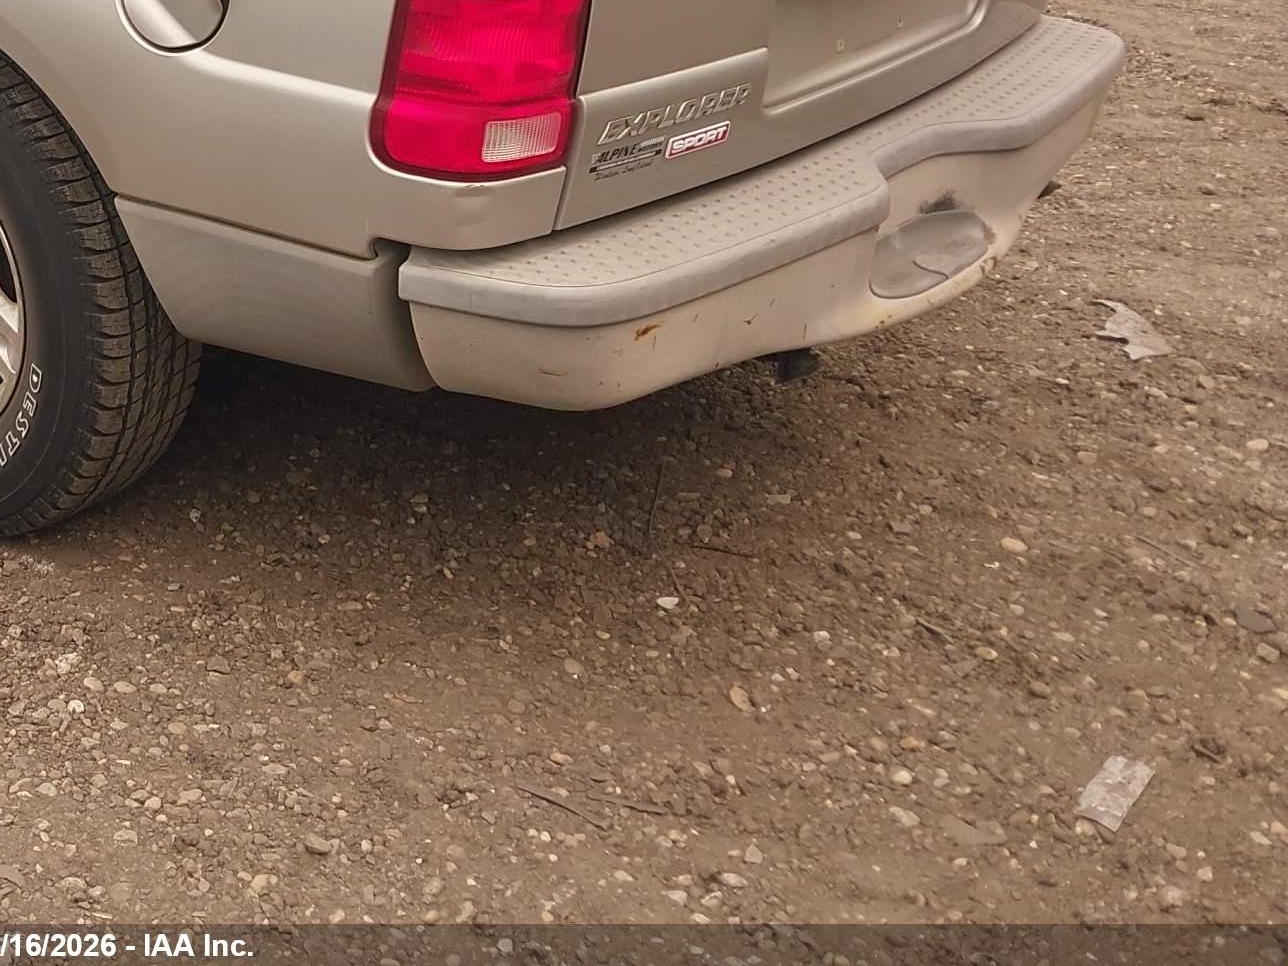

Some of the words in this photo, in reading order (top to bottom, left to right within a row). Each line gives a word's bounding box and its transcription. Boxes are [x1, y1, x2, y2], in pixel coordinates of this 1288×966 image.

[597, 83, 753, 146] EXPLORER
[595, 143, 641, 164] ALPINE
[672, 125, 729, 154] SPORT
